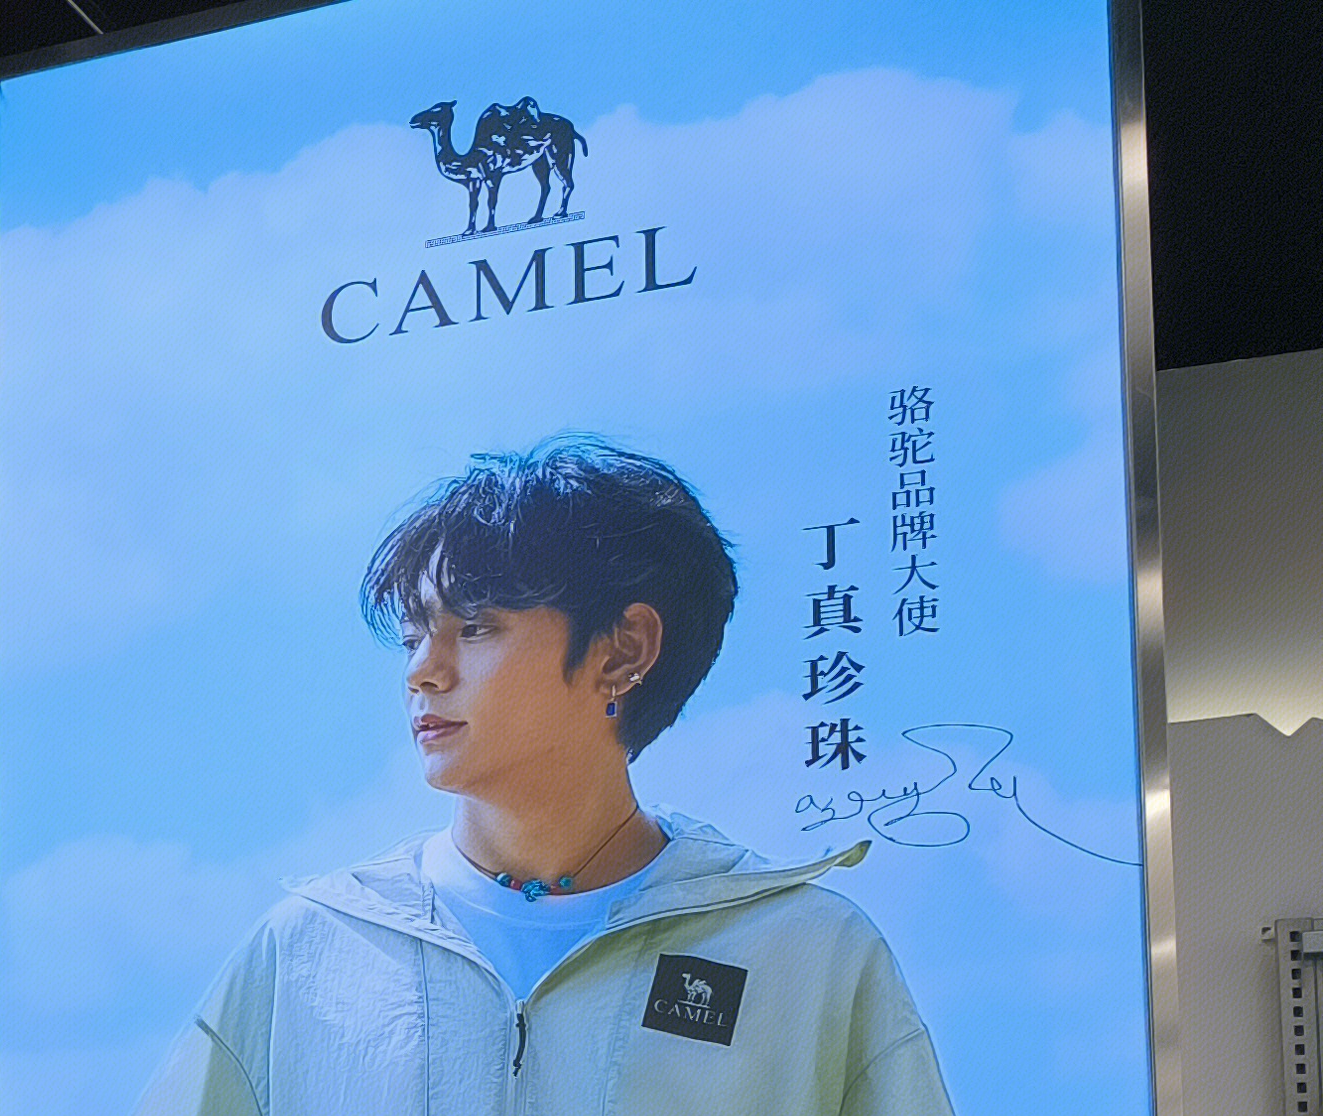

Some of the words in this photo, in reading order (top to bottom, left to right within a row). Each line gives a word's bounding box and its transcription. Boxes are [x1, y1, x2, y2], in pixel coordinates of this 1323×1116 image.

[320, 226, 697, 344] CAMEL
[888, 386, 940, 638] 骆驼品牌大使
[801, 517, 868, 772] 丁真珍珠
[654, 999, 728, 1027] CAMEL
